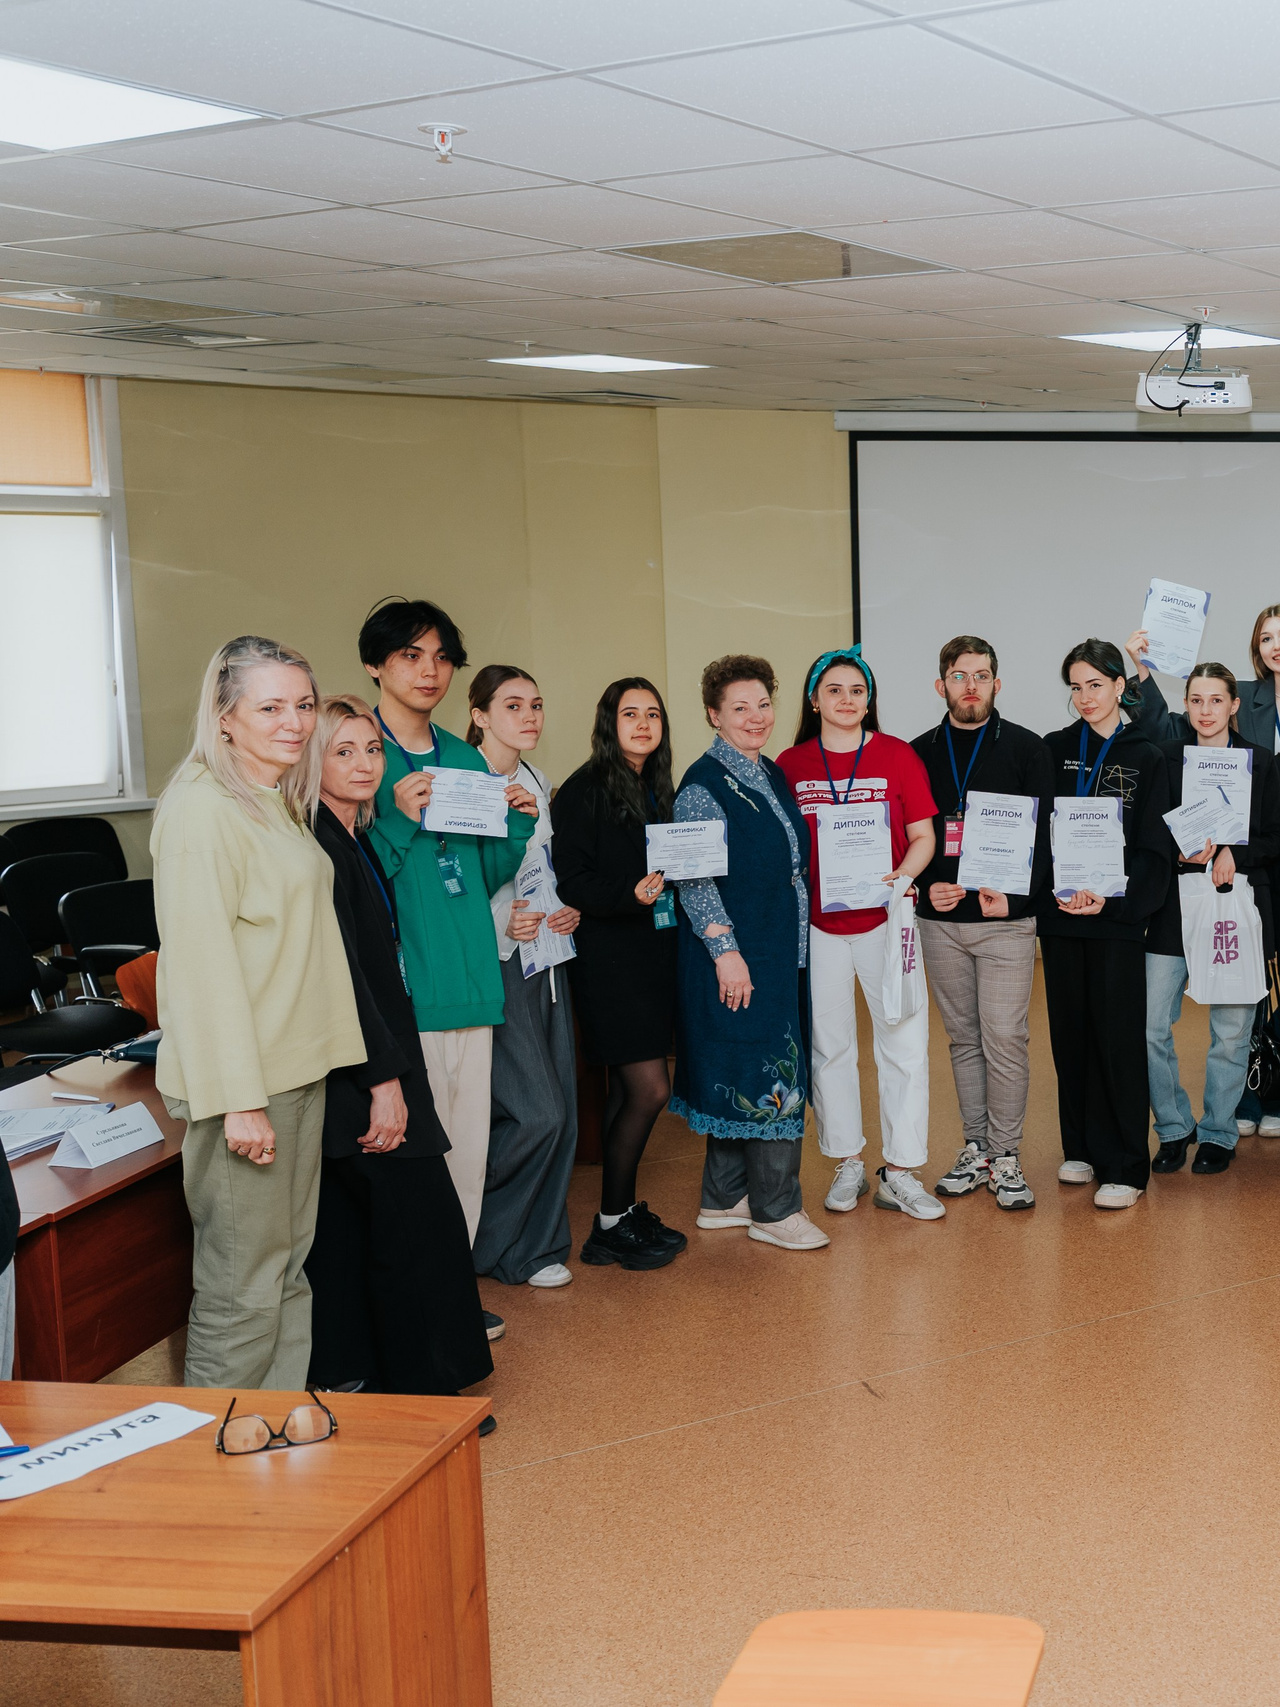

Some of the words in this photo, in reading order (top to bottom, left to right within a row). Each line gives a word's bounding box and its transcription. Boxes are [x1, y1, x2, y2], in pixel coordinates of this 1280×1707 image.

[1161, 595, 1196, 609] ДИПЛОМ
[1198, 762, 1237, 770] ДИПЛОМ
[981, 808, 1022, 818] ДИПЛОМ
[1178, 798, 1208, 817] СЕРТИФИКАТ
[444, 820, 487, 829] СЕРТИФИКАТ
[667, 826, 707, 834] СЕРТИФИКАТ
[833, 819, 875, 830] ДИПЛОМ
[979, 846, 1015, 854] СЕРТИФИКАТ
[1214, 920, 1237, 935] ЯР
[1213, 935, 1239, 950] ПИ
[1212, 950, 1239, 964] АР
[19, 1414, 161, 1470] минута
